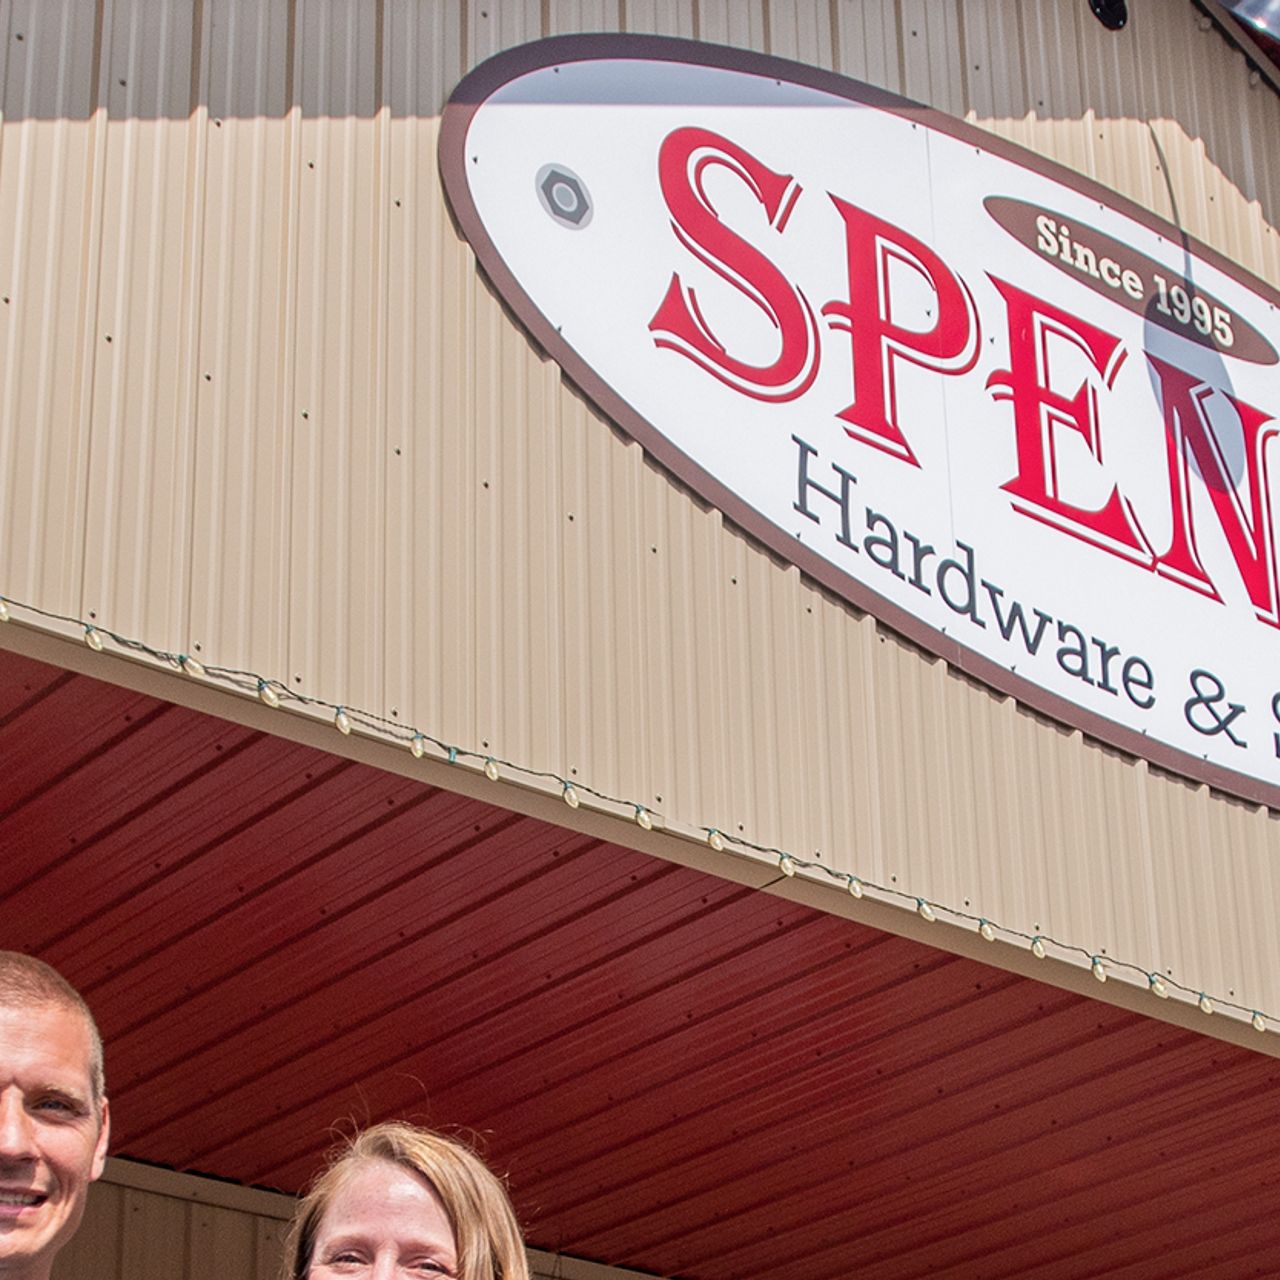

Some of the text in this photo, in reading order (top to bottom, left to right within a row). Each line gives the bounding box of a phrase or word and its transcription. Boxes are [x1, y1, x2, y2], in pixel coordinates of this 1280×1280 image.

[1036, 215, 1234, 347] Since 1995
[791, 433, 1155, 710] Hardware
[1183, 668, 1248, 748] &
